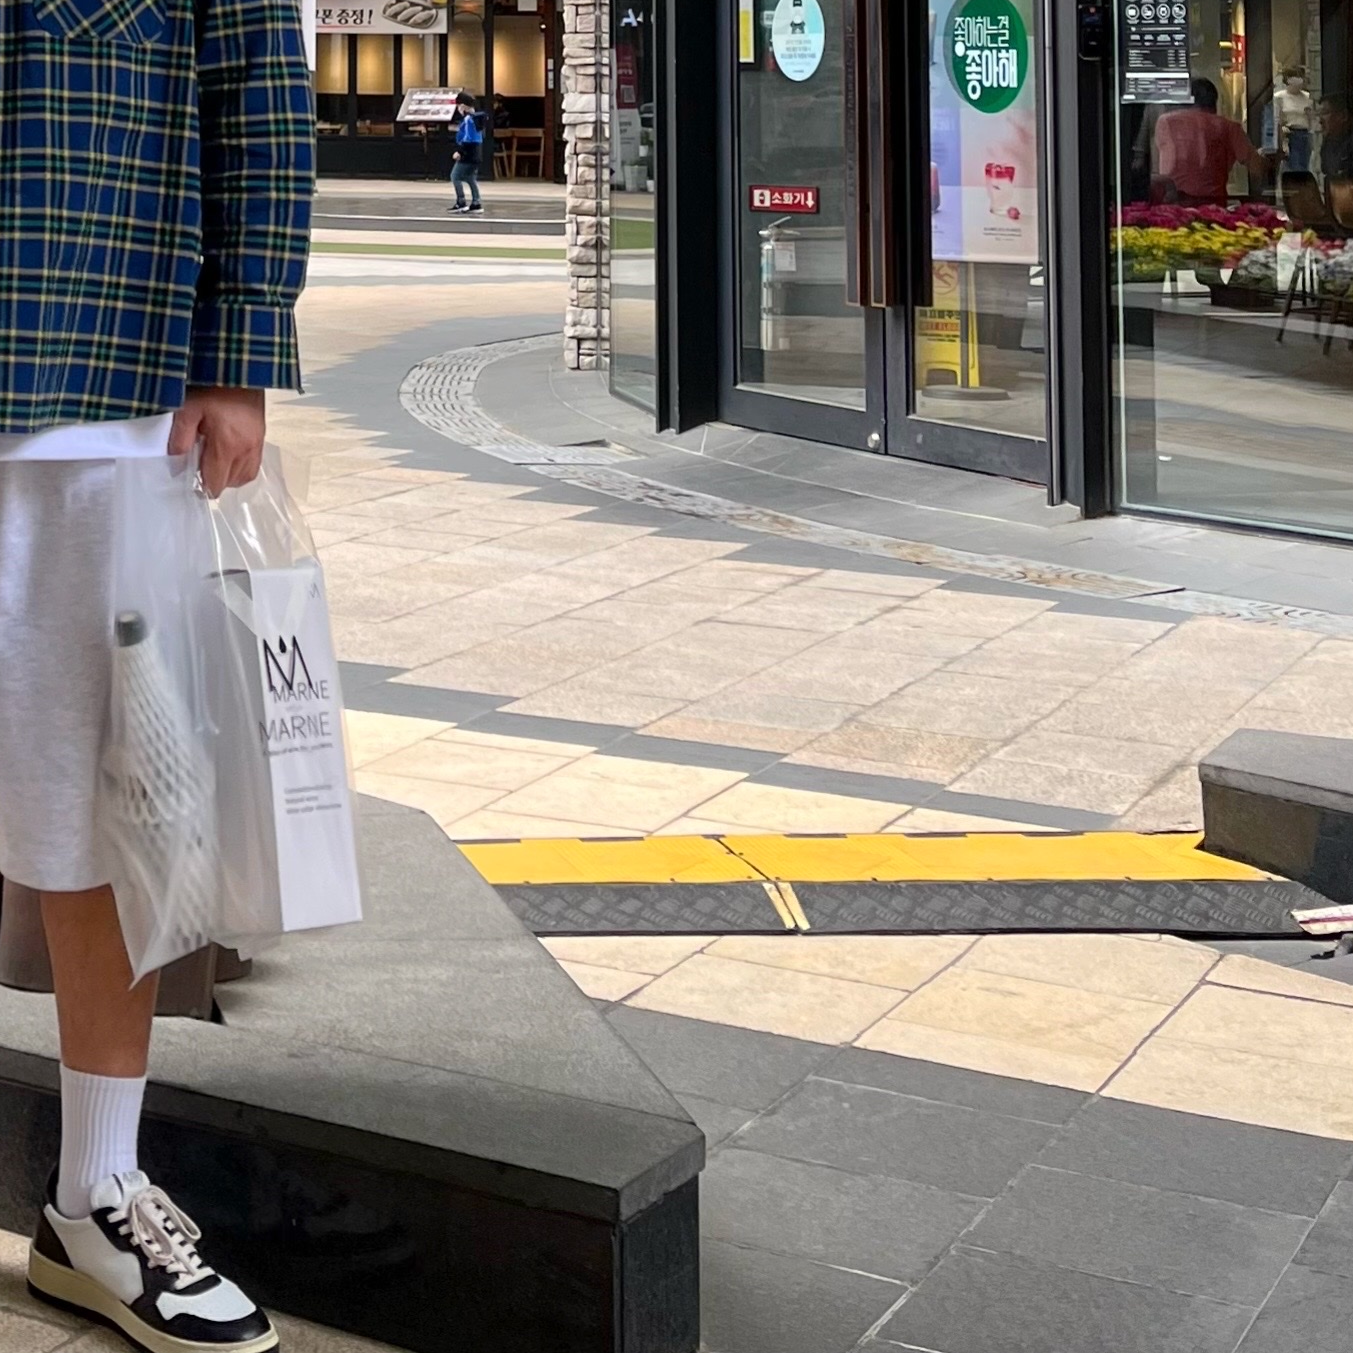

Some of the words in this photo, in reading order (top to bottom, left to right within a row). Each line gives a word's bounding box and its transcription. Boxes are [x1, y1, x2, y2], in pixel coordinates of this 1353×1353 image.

[965, 49, 1018, 100] 좋아해
[771, 191, 805, 205] 소화기
[258, 711, 333, 745] MARNE
